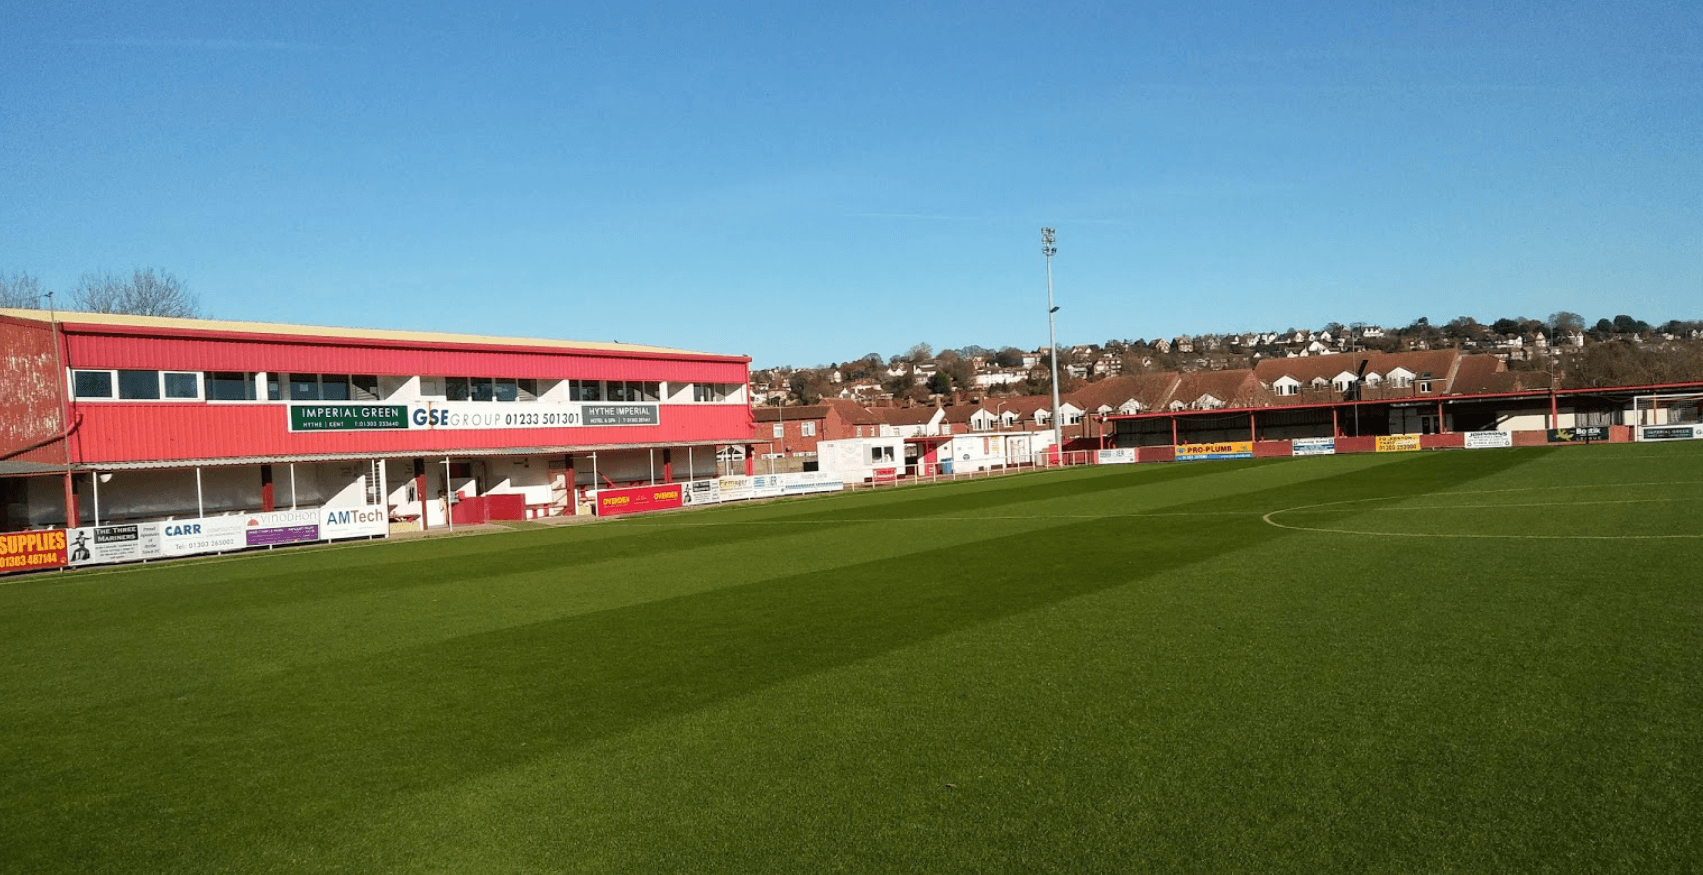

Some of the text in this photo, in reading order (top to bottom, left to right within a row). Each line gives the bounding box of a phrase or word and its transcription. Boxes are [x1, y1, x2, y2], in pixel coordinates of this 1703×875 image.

[301, 407, 399, 418] IMPERIAL GREEN
[412, 408, 580, 426] GSE GROUP 01233 501301
[589, 407, 650, 416] HYTHE IMPERIAL
[327, 509, 383, 526] AMTech
[165, 524, 202, 536] CARR
[0, 531, 66, 555] SUPPLIES
[98, 534, 136, 542] MARINERS
[0, 552, 57, 568] 01303 487144
